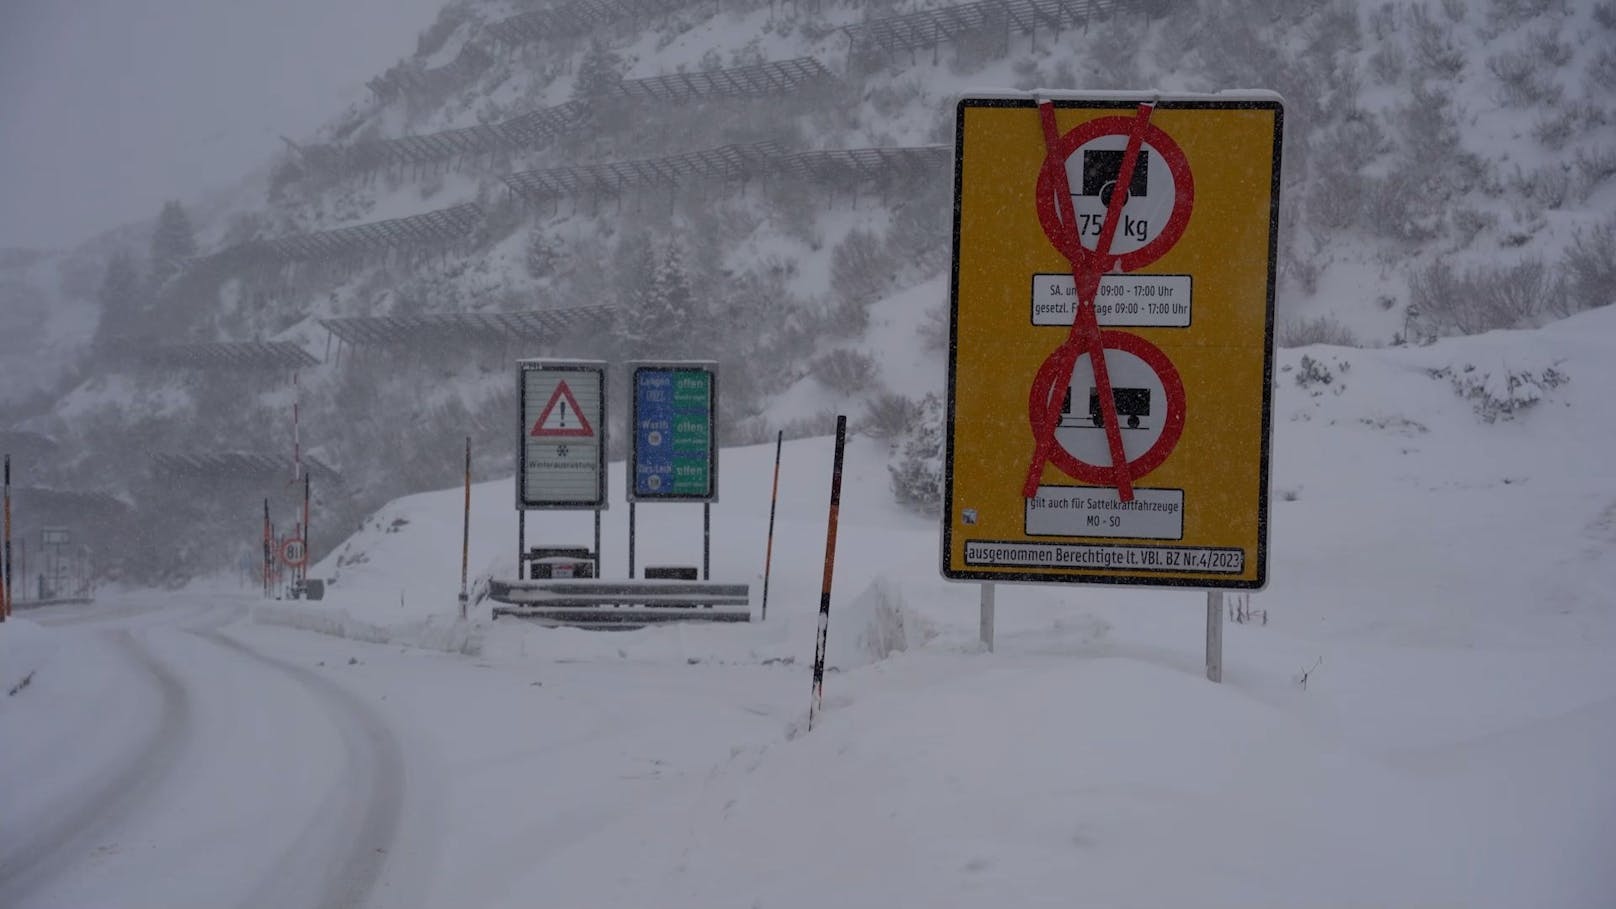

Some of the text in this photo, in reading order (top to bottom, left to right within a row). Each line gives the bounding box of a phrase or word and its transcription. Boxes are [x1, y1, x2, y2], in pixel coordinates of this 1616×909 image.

[1080, 214, 1148, 242] 75 kg
[1050, 285, 1063, 296] SA.
[1066, 287, 1078, 297] un
[1101, 286, 1124, 298] 09:00
[1134, 286, 1155, 298] 17:00
[1158, 286, 1174, 298] Uhr
[1035, 302, 1069, 315] gesetzl.
[1115, 303, 1138, 315] 09:00
[1148, 303, 1170, 315] 17:00
[1173, 303, 1188, 315] Uhr
[1031, 498, 1180, 515] gilt auch für Sattelkraftfahrzeuge
[1087, 516, 1101, 527] MO
[1109, 516, 1121, 528] SO
[969, 547, 1053, 563] ausgenommen
[1056, 548, 1124, 567] Berechtigte
[1126, 551, 1139, 565] lt.
[1166, 552, 1181, 567] BZ
